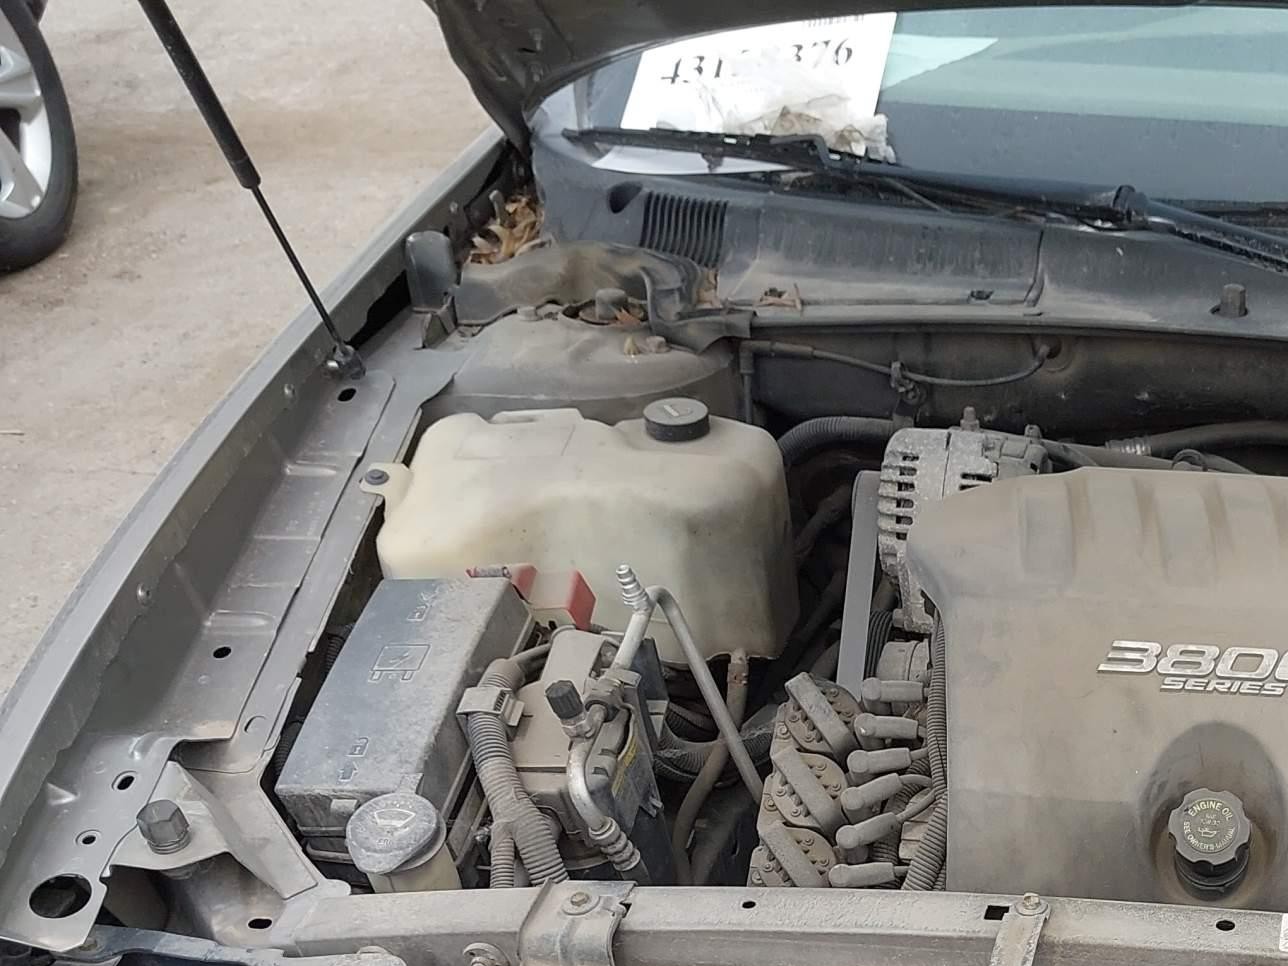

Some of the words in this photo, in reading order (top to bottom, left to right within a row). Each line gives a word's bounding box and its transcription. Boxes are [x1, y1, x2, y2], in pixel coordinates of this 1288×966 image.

[1160, 676, 1287, 697] SERIES
[1188, 800, 1222, 817] ENGINE
[1222, 807, 1233, 821] OIL
